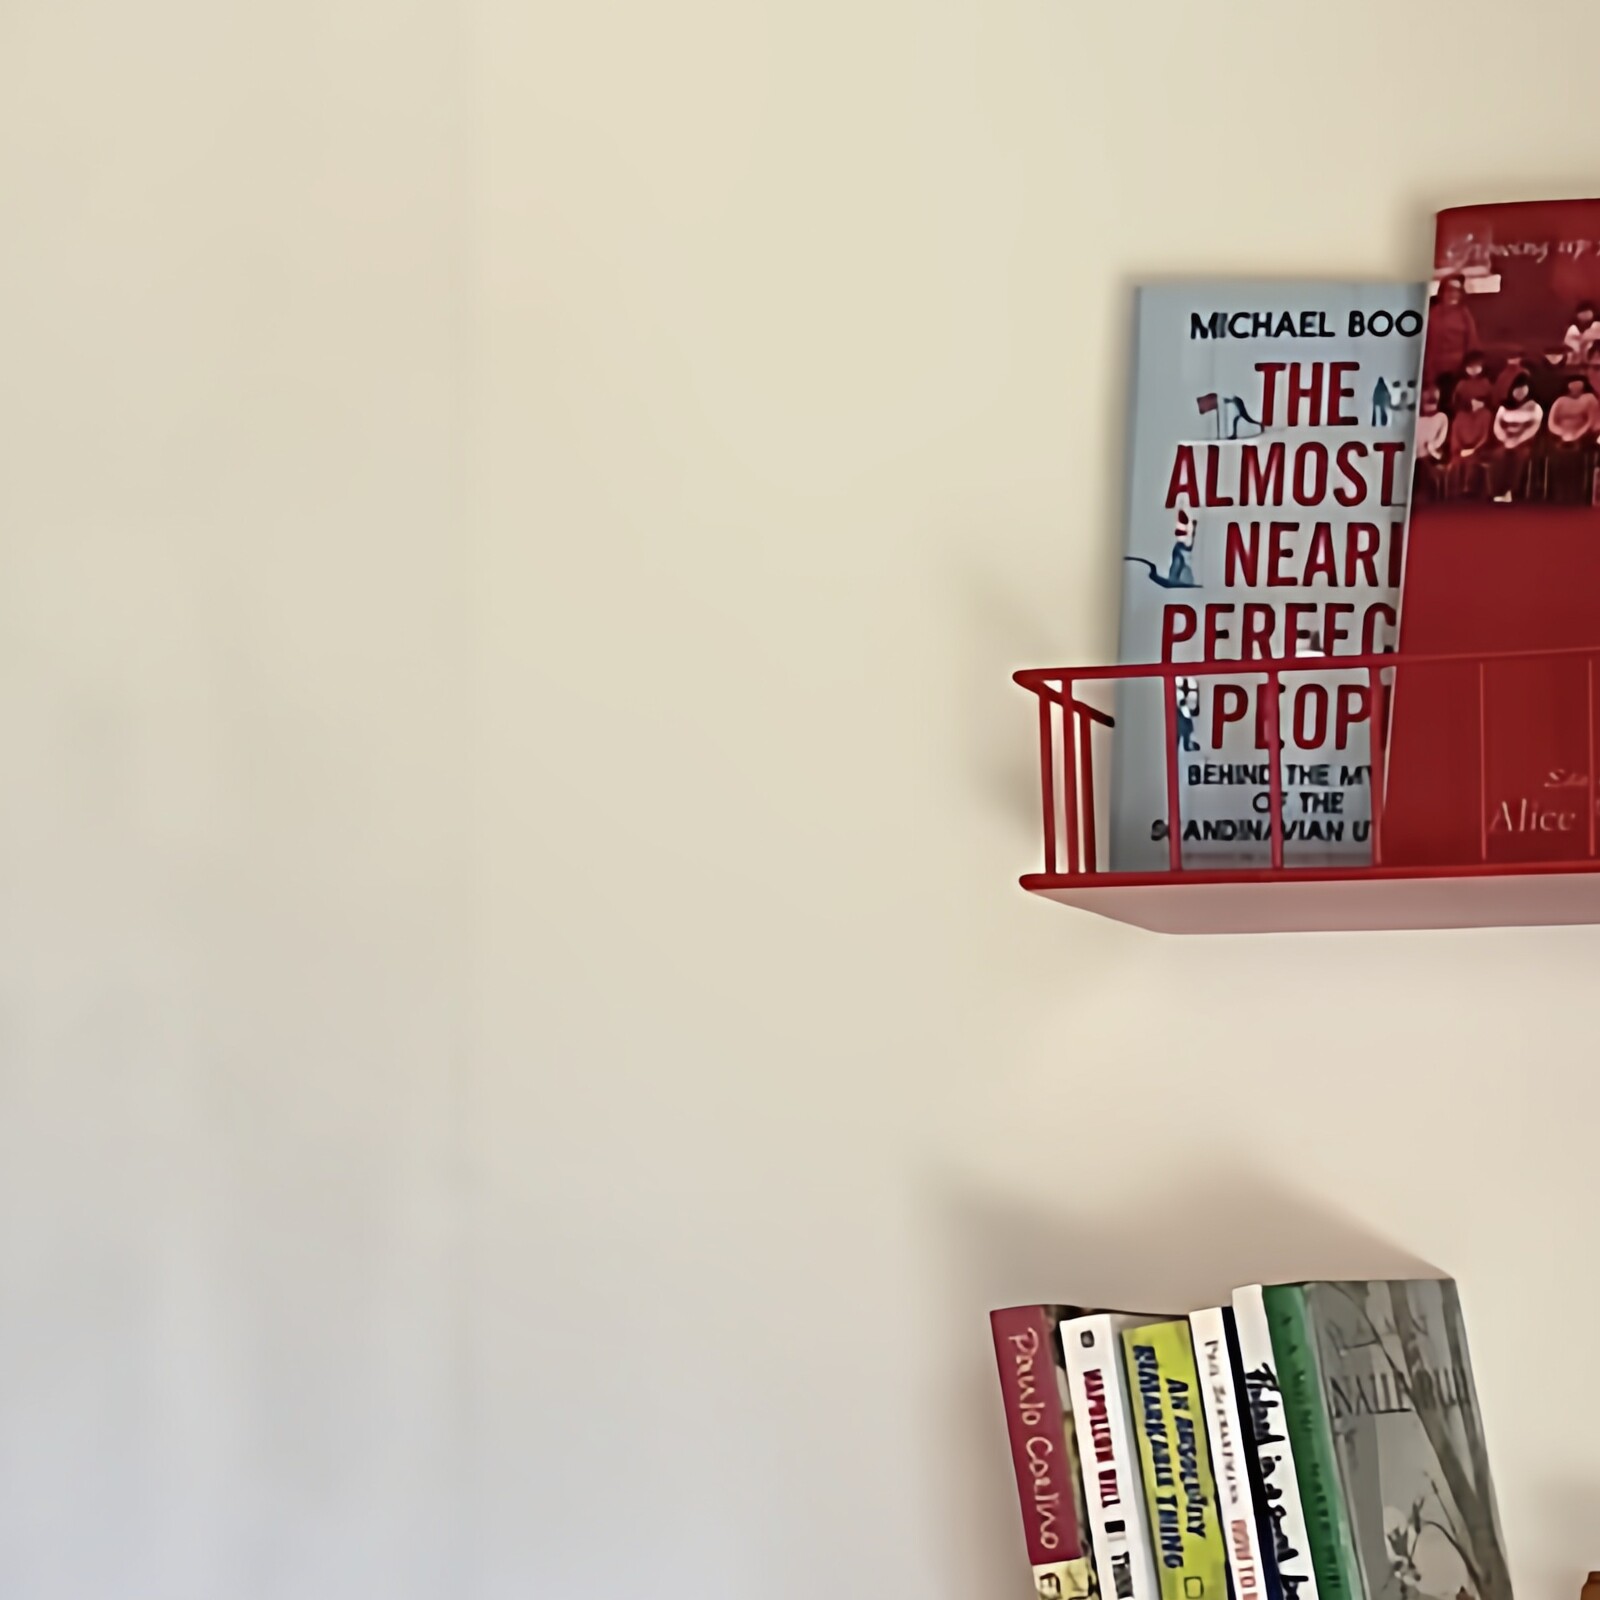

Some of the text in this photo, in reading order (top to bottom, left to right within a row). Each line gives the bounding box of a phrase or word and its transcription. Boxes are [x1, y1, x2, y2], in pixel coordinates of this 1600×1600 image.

[1190, 310, 1424, 340] MICHAEL BOO
[1254, 362, 1361, 427] THE
[1165, 441, 1406, 509] ALMOST
[1161, 602, 1397, 665] PERFEC
[1188, 764, 1270, 786] BEHIND
[1286, 764, 1329, 786] THE
[1252, 791, 1344, 814] OF THE
[1489, 798, 1577, 832] Alice
[1150, 819, 1344, 841] SANDINAVIAN
[1007, 1327, 1046, 1426] Paulo
[1165, 1378, 1190, 1411] AN
[1155, 1494, 1185, 1569] THING
[1237, 1564, 1257, 1588] TO
